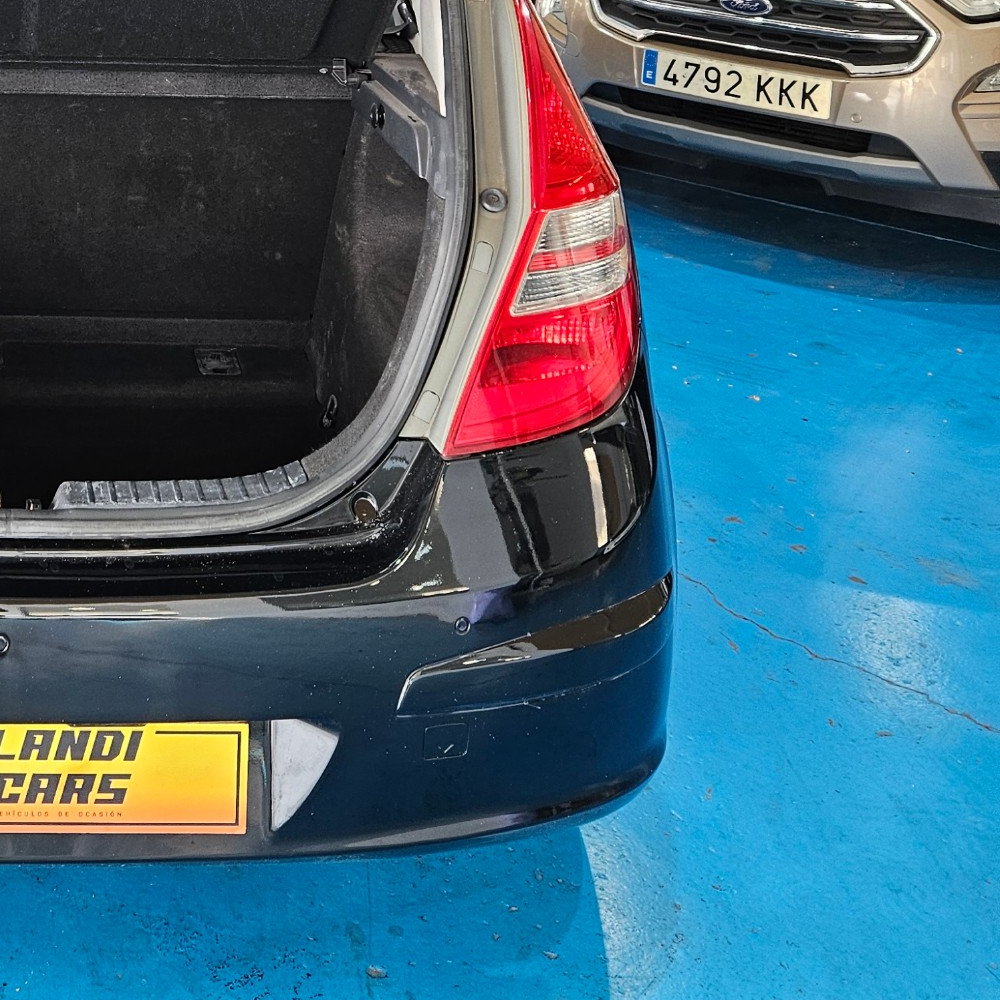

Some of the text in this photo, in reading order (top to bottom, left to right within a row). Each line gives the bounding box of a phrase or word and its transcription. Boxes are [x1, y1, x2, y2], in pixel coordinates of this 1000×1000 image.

[646, 58, 821, 113] E 4792 KKK
[78, 809, 122, 818] OCASIÓN
